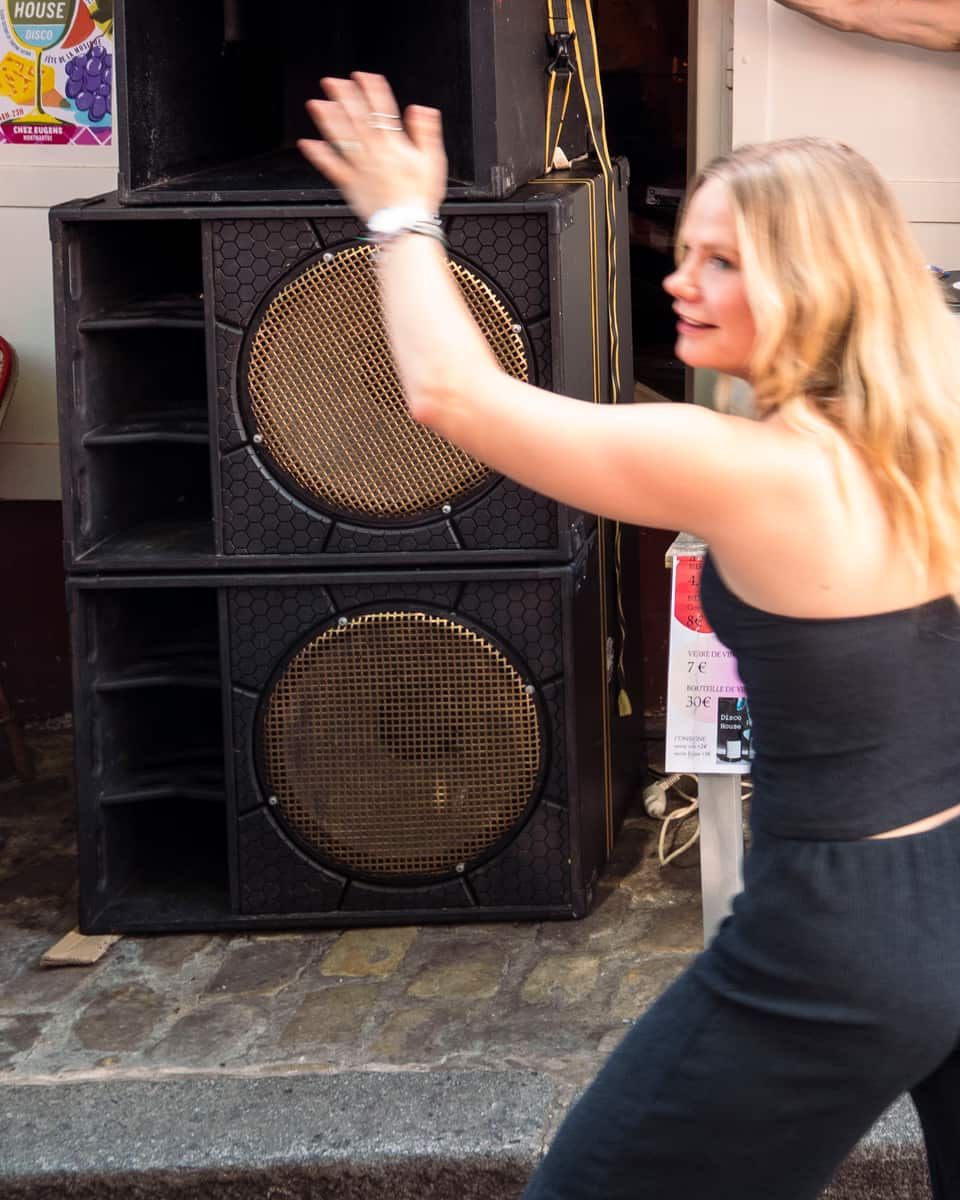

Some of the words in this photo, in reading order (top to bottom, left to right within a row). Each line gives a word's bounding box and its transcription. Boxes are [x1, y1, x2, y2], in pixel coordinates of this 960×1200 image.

[14, 2, 66, 19] HOUSE
[25, 30, 53, 41] DISCO
[13, 126, 33, 134] CHEZ
[688, 661, 694, 673] 7
[698, 661, 707, 673] €
[687, 685, 723, 693] BOUTEILLE
[686, 695, 712, 708] 30€
